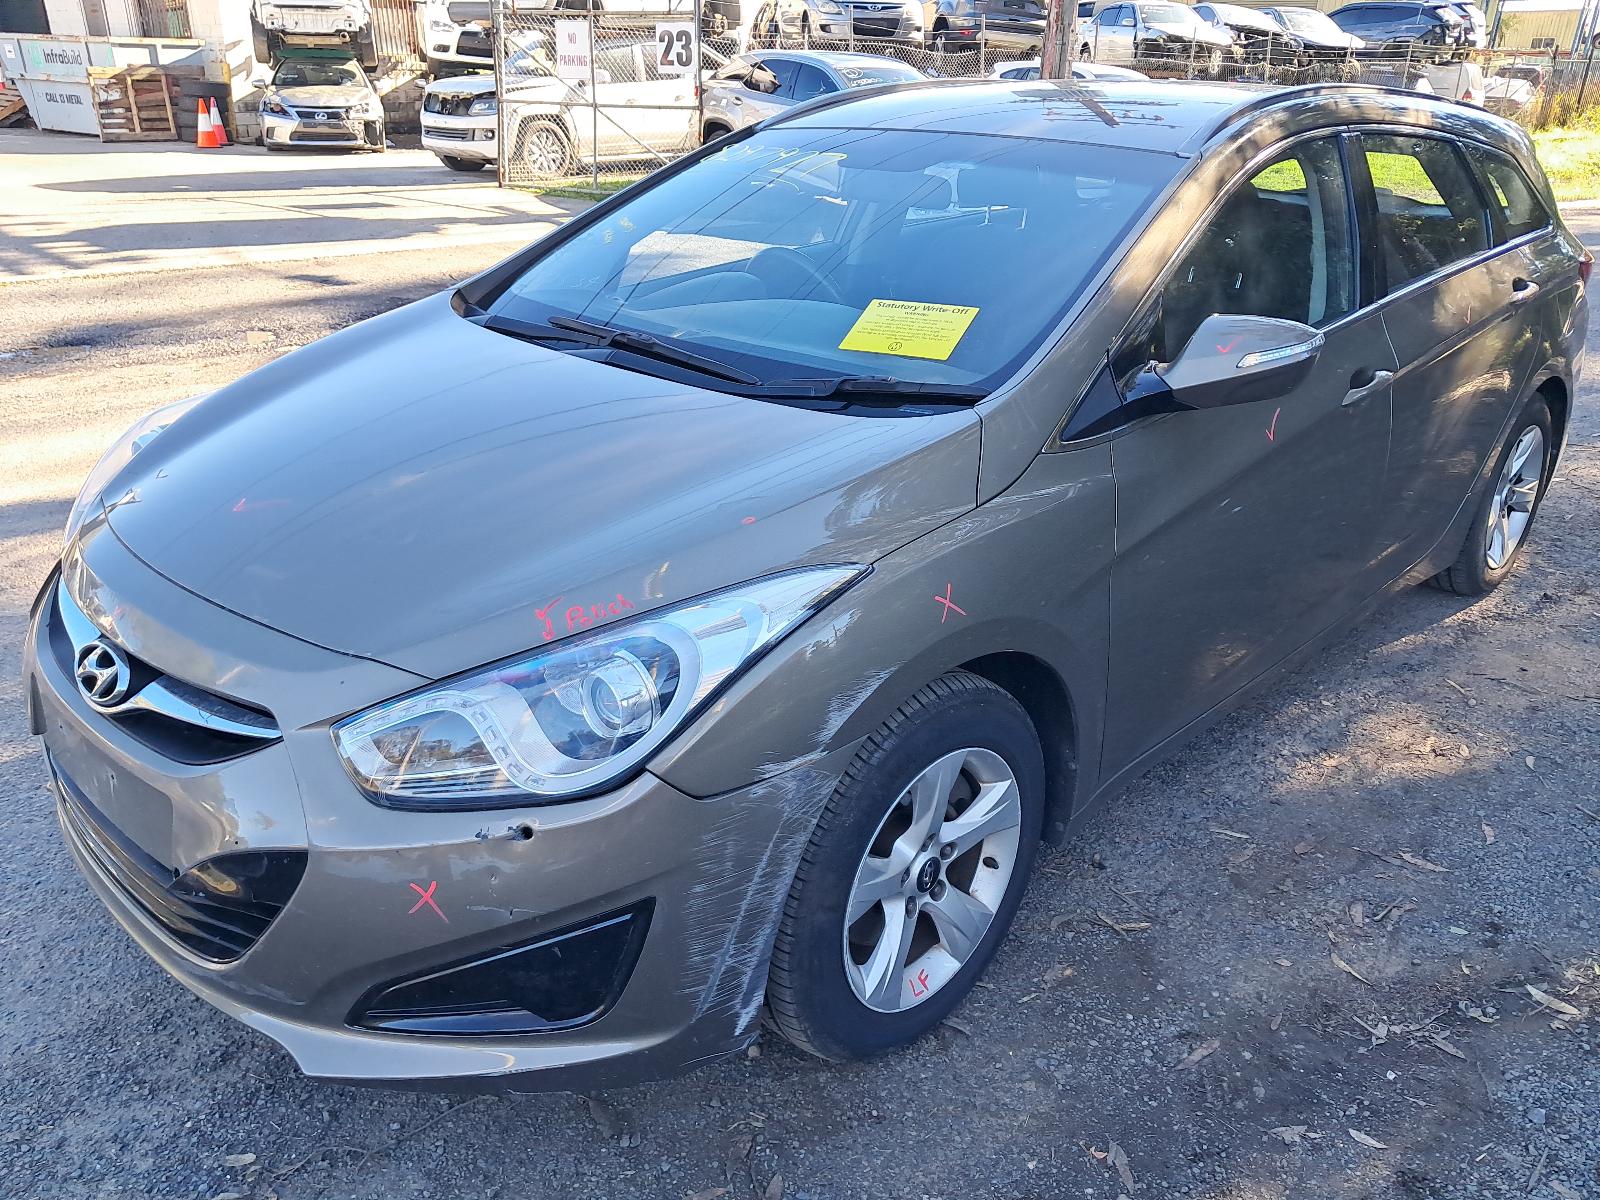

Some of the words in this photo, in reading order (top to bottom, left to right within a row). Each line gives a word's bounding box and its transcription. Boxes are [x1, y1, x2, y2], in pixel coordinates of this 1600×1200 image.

[567, 32, 577, 45] NO
[658, 29, 693, 67] 23
[43, 49, 82, 65] InfraBuild
[559, 55, 588, 67] PARKING
[45, 92, 59, 104] CALL
[876, 301, 921, 312] Statutory
[922, 305, 970, 316] Write-Off
[908, 968, 929, 997] LF
